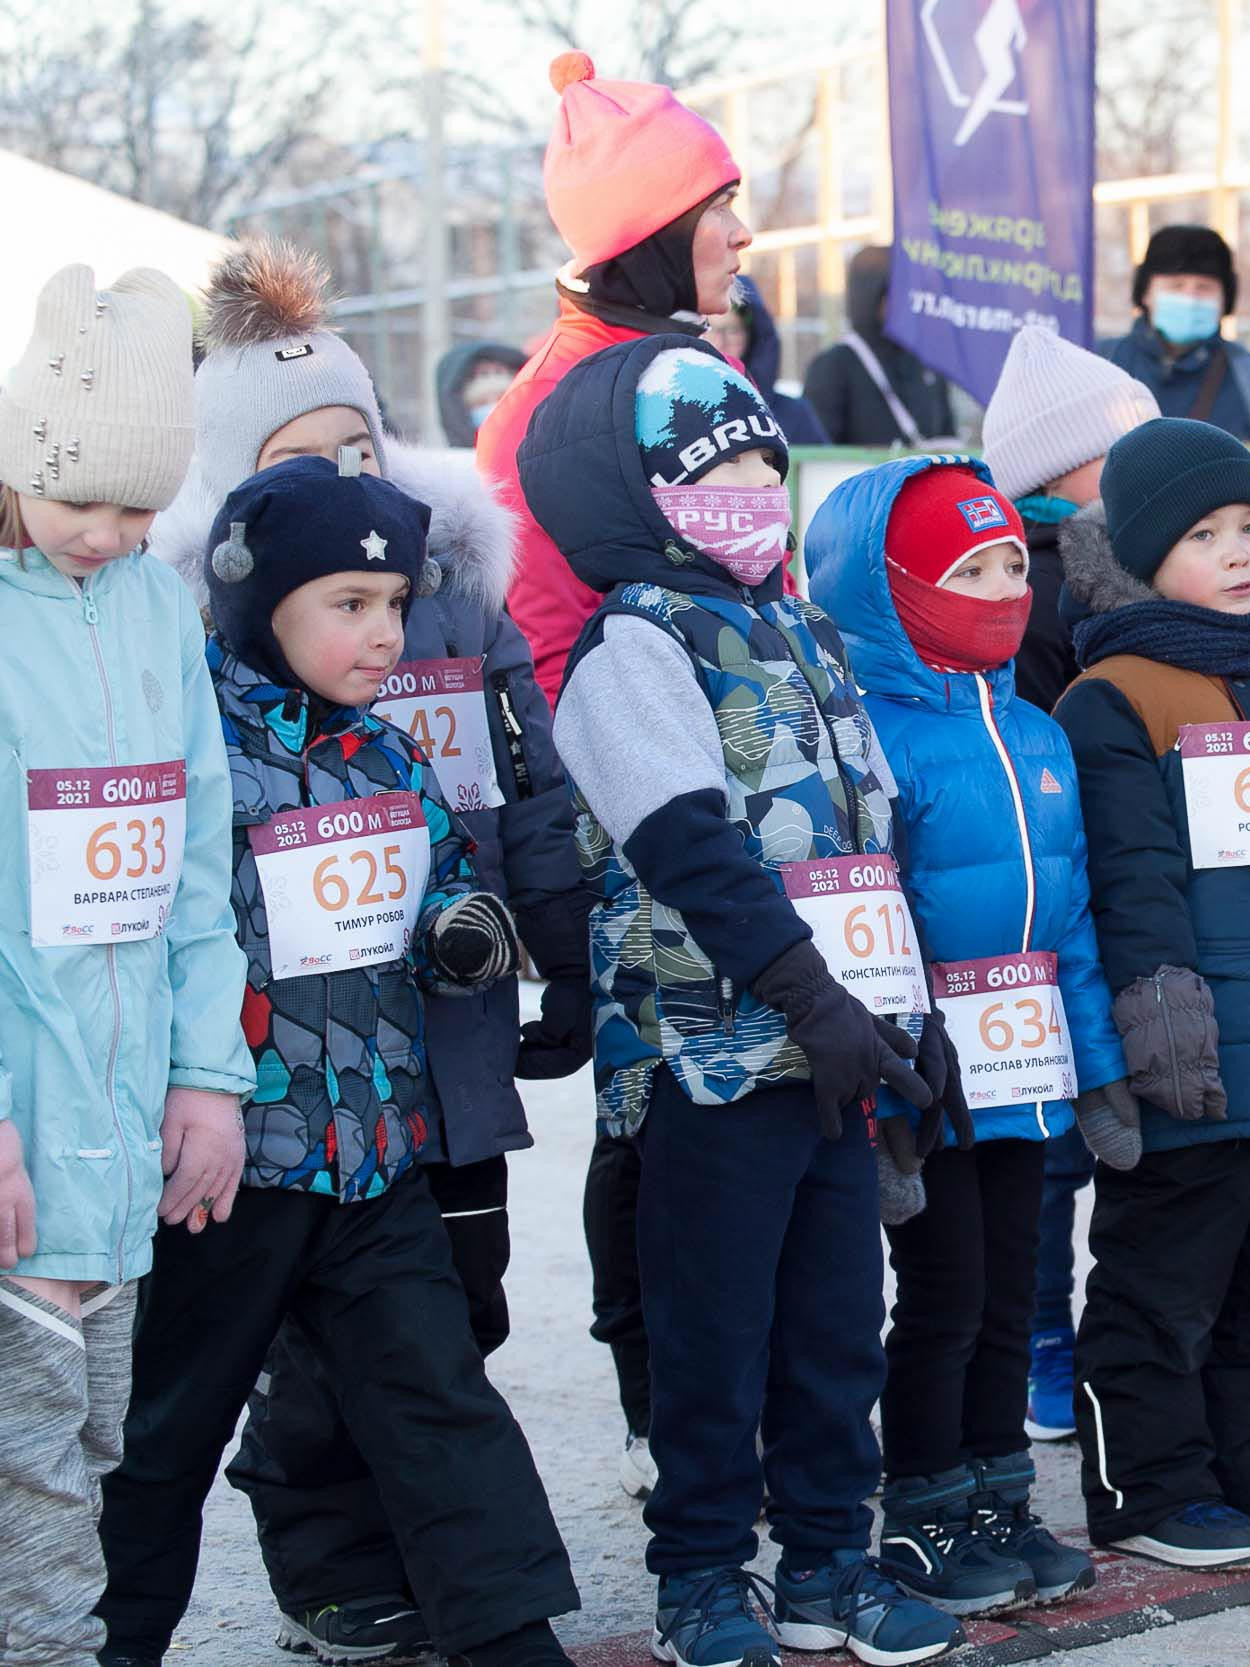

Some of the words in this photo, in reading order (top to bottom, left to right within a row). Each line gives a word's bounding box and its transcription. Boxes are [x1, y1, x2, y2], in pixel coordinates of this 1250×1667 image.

[381, 706, 461, 759] 42
[1204, 732, 1233, 742] 05.12
[1206, 742, 1233, 753] 2021
[56, 780, 91, 792] 05.12
[102, 777, 142, 803] 600
[57, 792, 90, 805] 2021
[274, 821, 306, 835] 05.12
[317, 811, 364, 839] 600
[277, 832, 308, 847] 2021
[86, 816, 166, 880] 633
[313, 845, 407, 911] 625
[809, 868, 839, 881] 05.12
[849, 865, 885, 888] 600
[812, 880, 840, 893] 2021
[74, 890, 129, 905] ВАРВАРА
[120, 919, 150, 934] ЛУКОЙЛ
[335, 914, 374, 933] ТИМУР
[376, 909, 405, 925] РОБОВ
[843, 903, 911, 959] 612
[360, 943, 394, 958] ЛУКОЙЛ
[841, 966, 901, 981] КОНСТАНТИН
[946, 971, 976, 982] 05.12
[987, 963, 1031, 988] 600
[947, 981, 976, 993] 2021
[979, 998, 1063, 1052] 634
[969, 1059, 1023, 1075] ЯРОСЛАВ
[1021, 1083, 1054, 1096] ЛУКОЙЛ
